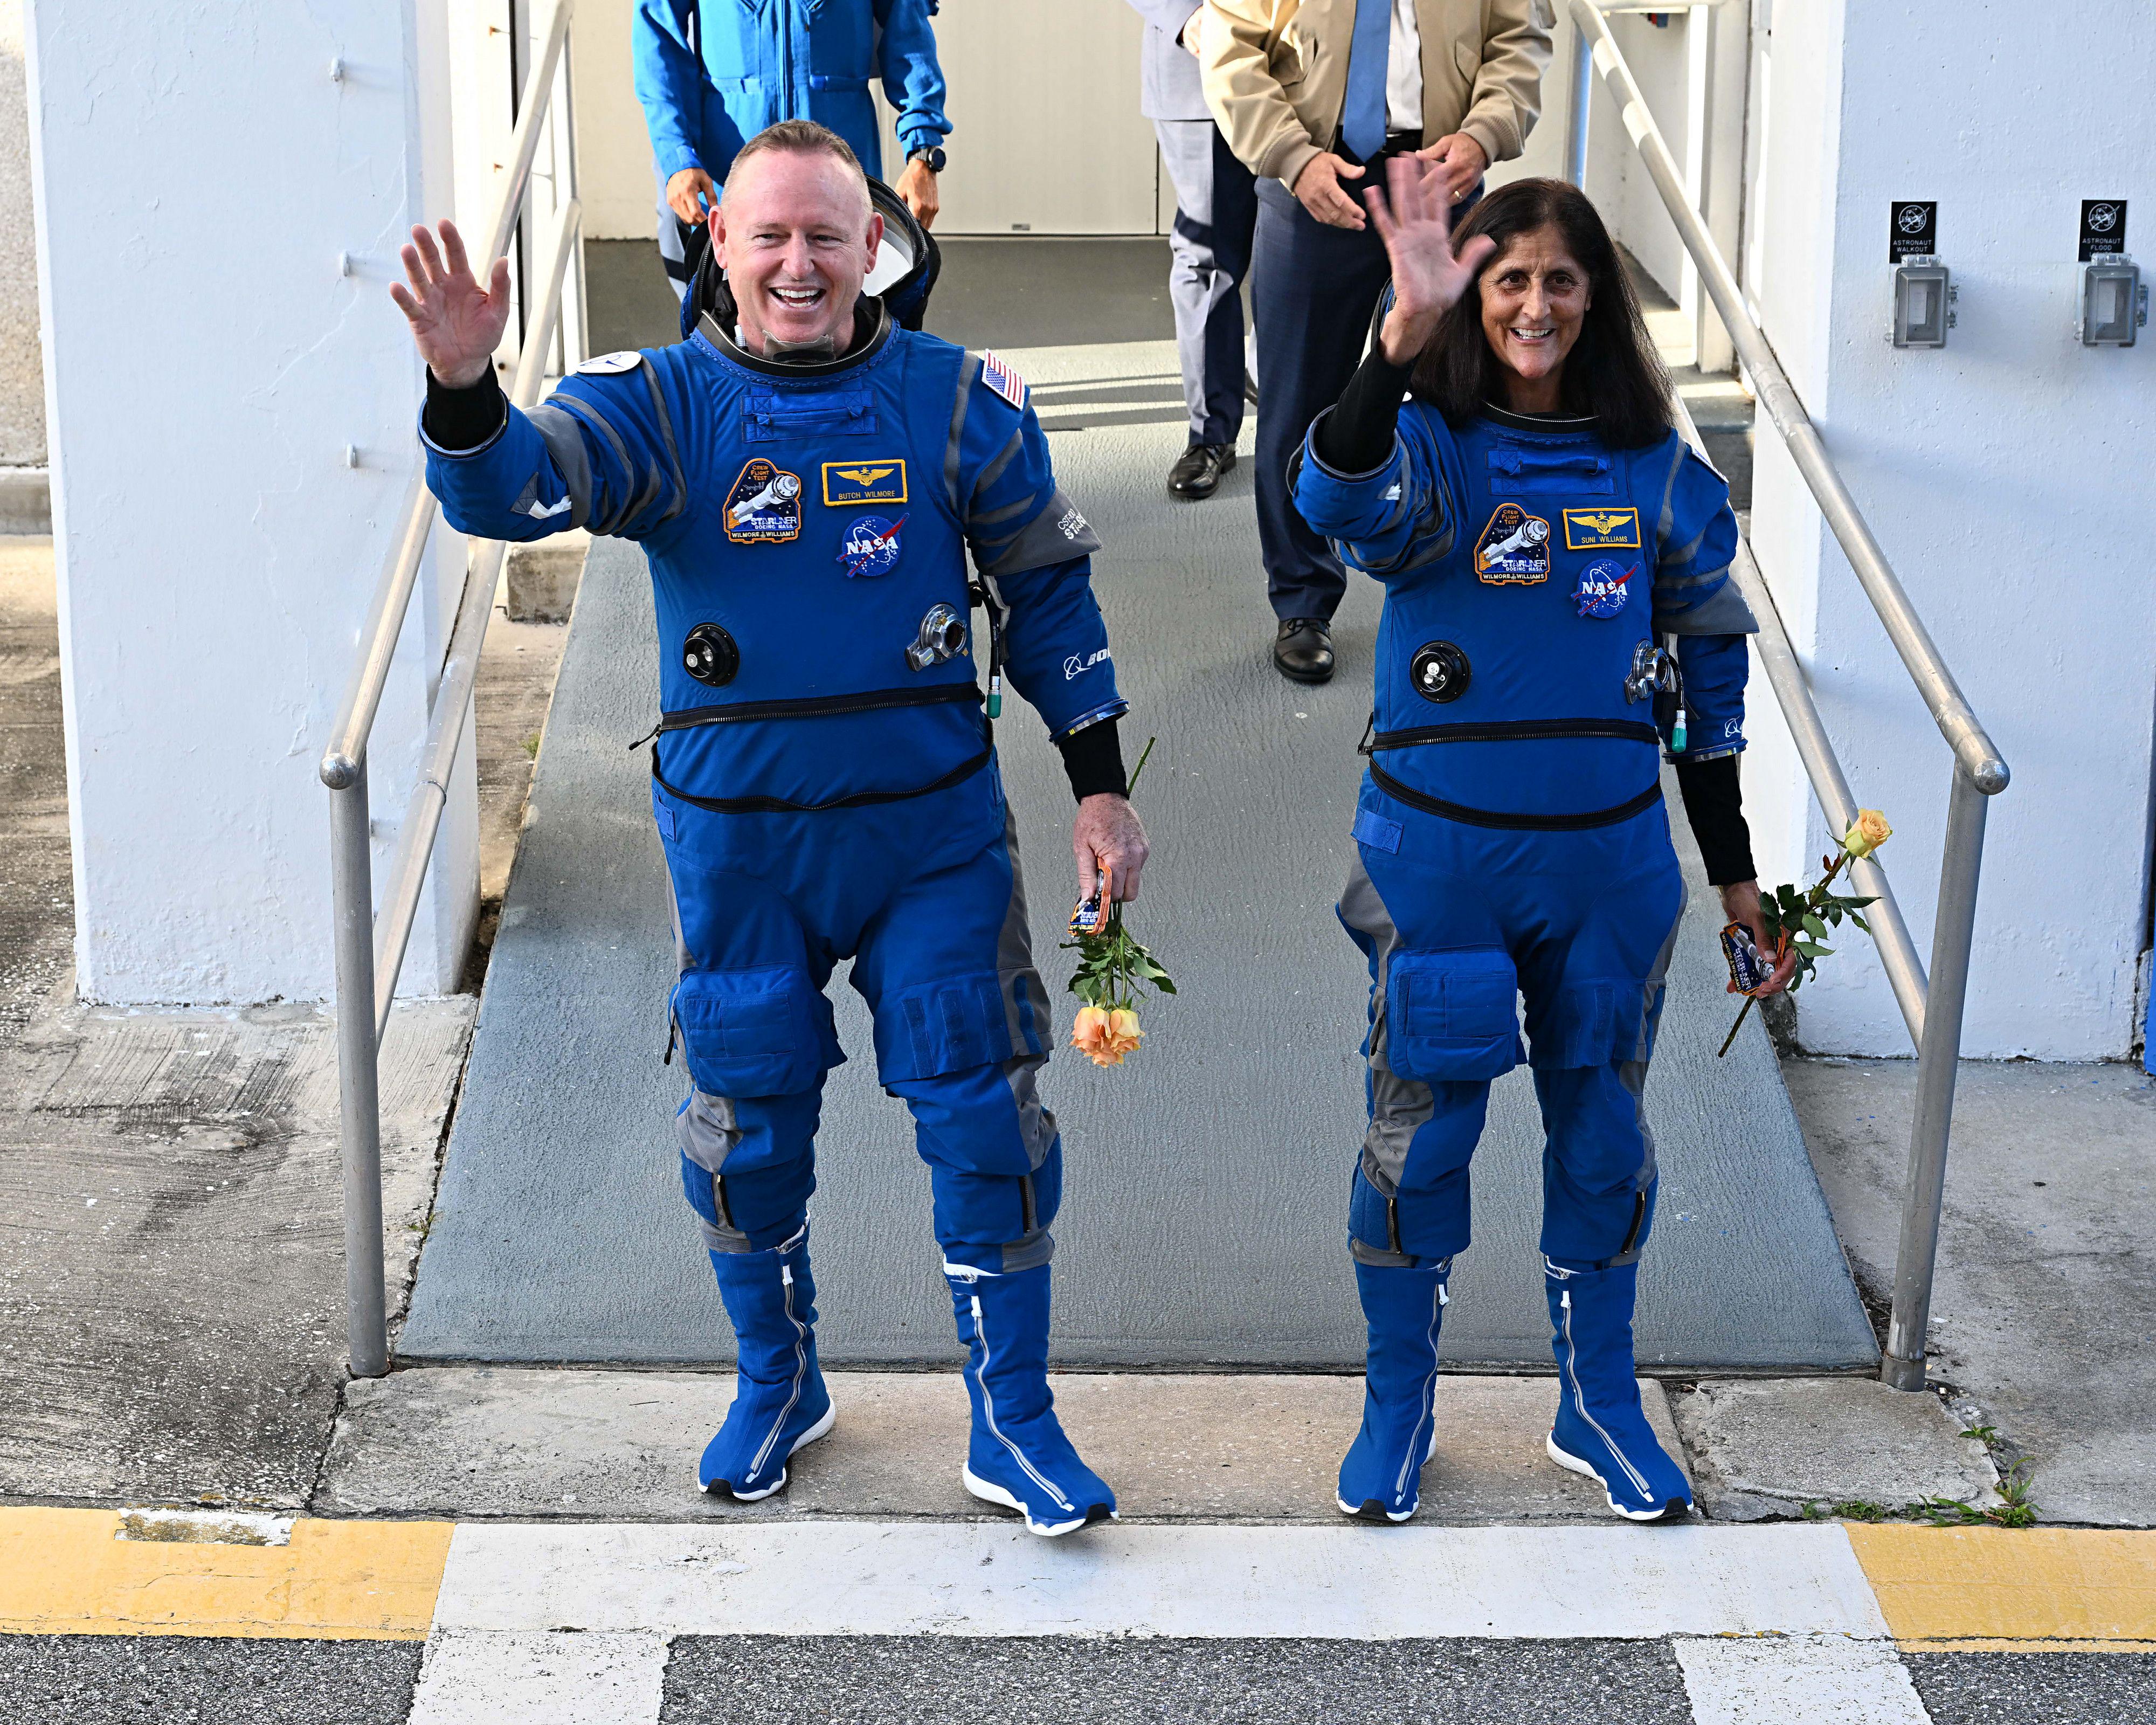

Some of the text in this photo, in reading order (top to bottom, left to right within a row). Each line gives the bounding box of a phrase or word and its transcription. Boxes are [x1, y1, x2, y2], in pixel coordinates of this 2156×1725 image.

[838, 492, 861, 500] BUTCH
[750, 516, 797, 526] STARLINER
[1064, 512, 1087, 540] STAR
[845, 536, 899, 555] NASA
[1502, 560, 1546, 568] STARLINER
[1581, 582, 1628, 596] NASA
[1087, 647, 1111, 666] BO
[1722, 934, 1742, 991] WILMORE WILLIAMS
[1736, 948, 1751, 990] STARLINER
